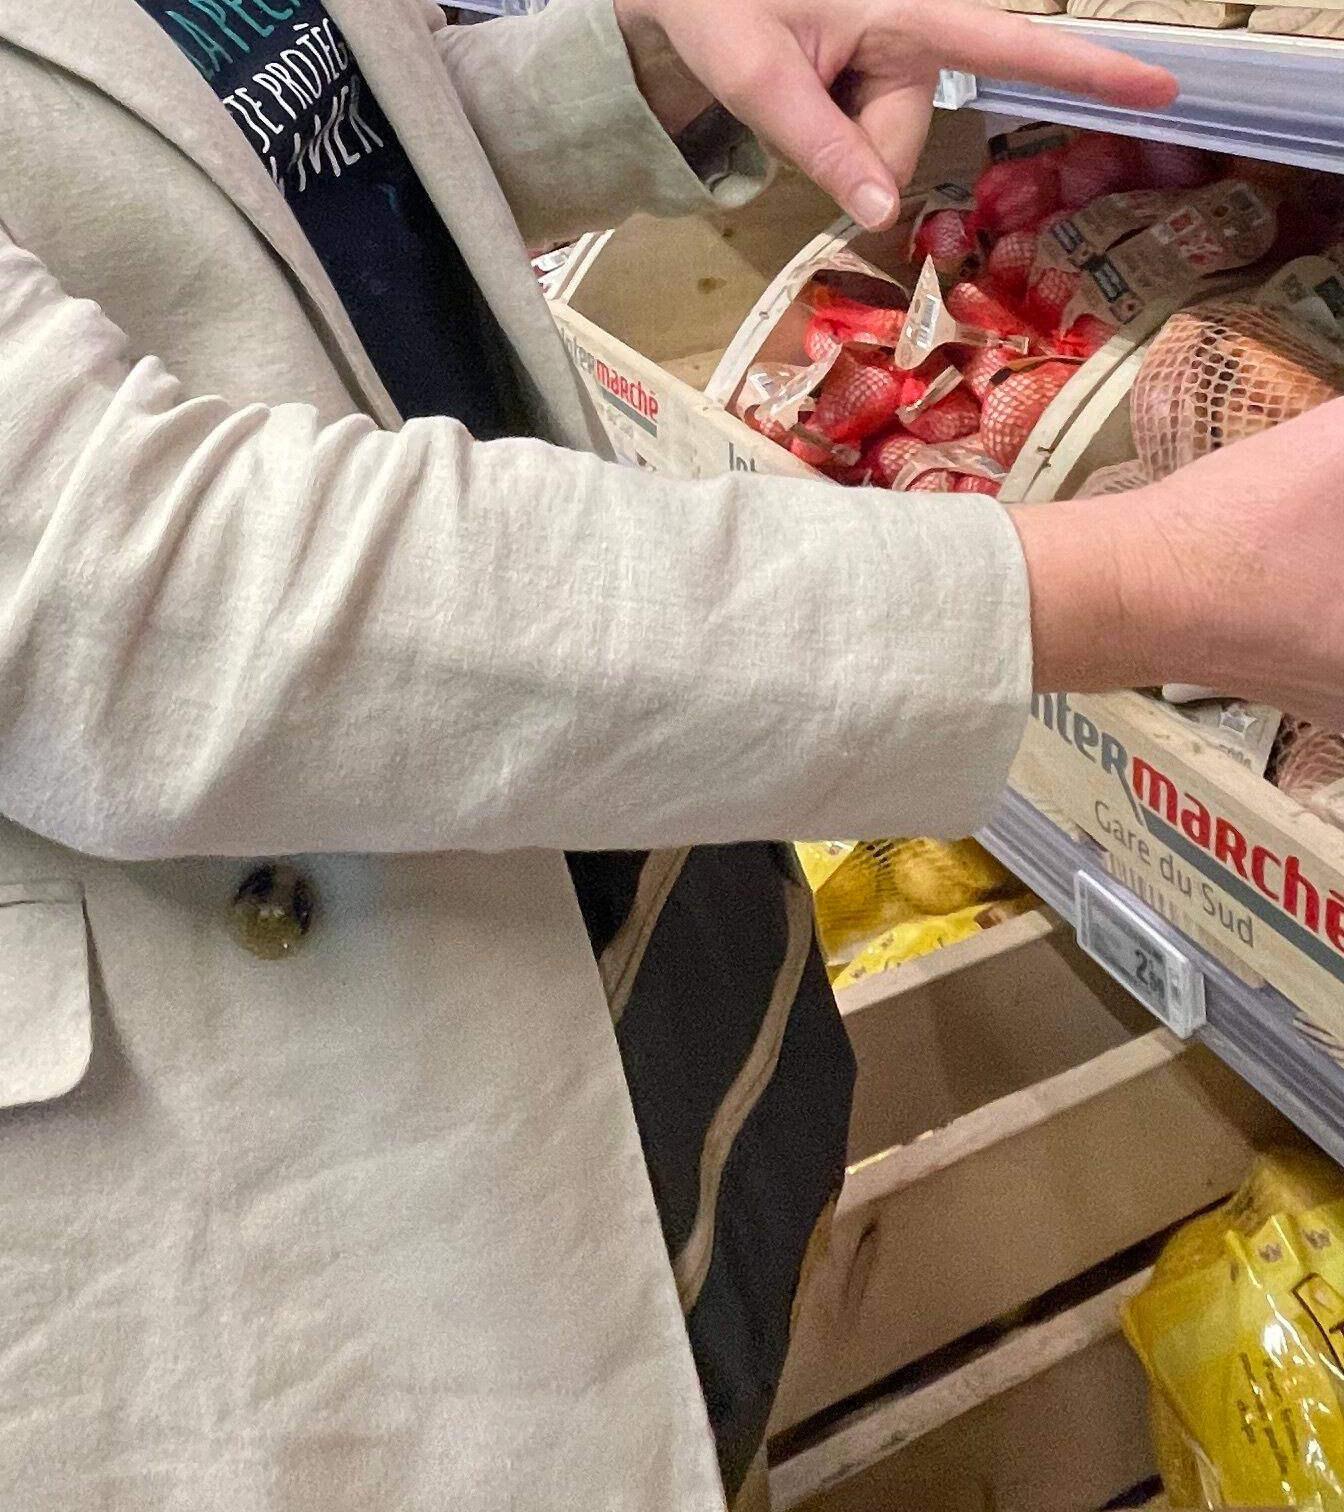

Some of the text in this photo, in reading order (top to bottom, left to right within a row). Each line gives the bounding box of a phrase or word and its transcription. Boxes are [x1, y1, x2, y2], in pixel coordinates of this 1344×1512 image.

[223, 87, 284, 153] JE
[1094, 799, 1150, 865] Gare
[1160, 853, 1193, 900] du
[1202, 885, 1256, 949] Sud
